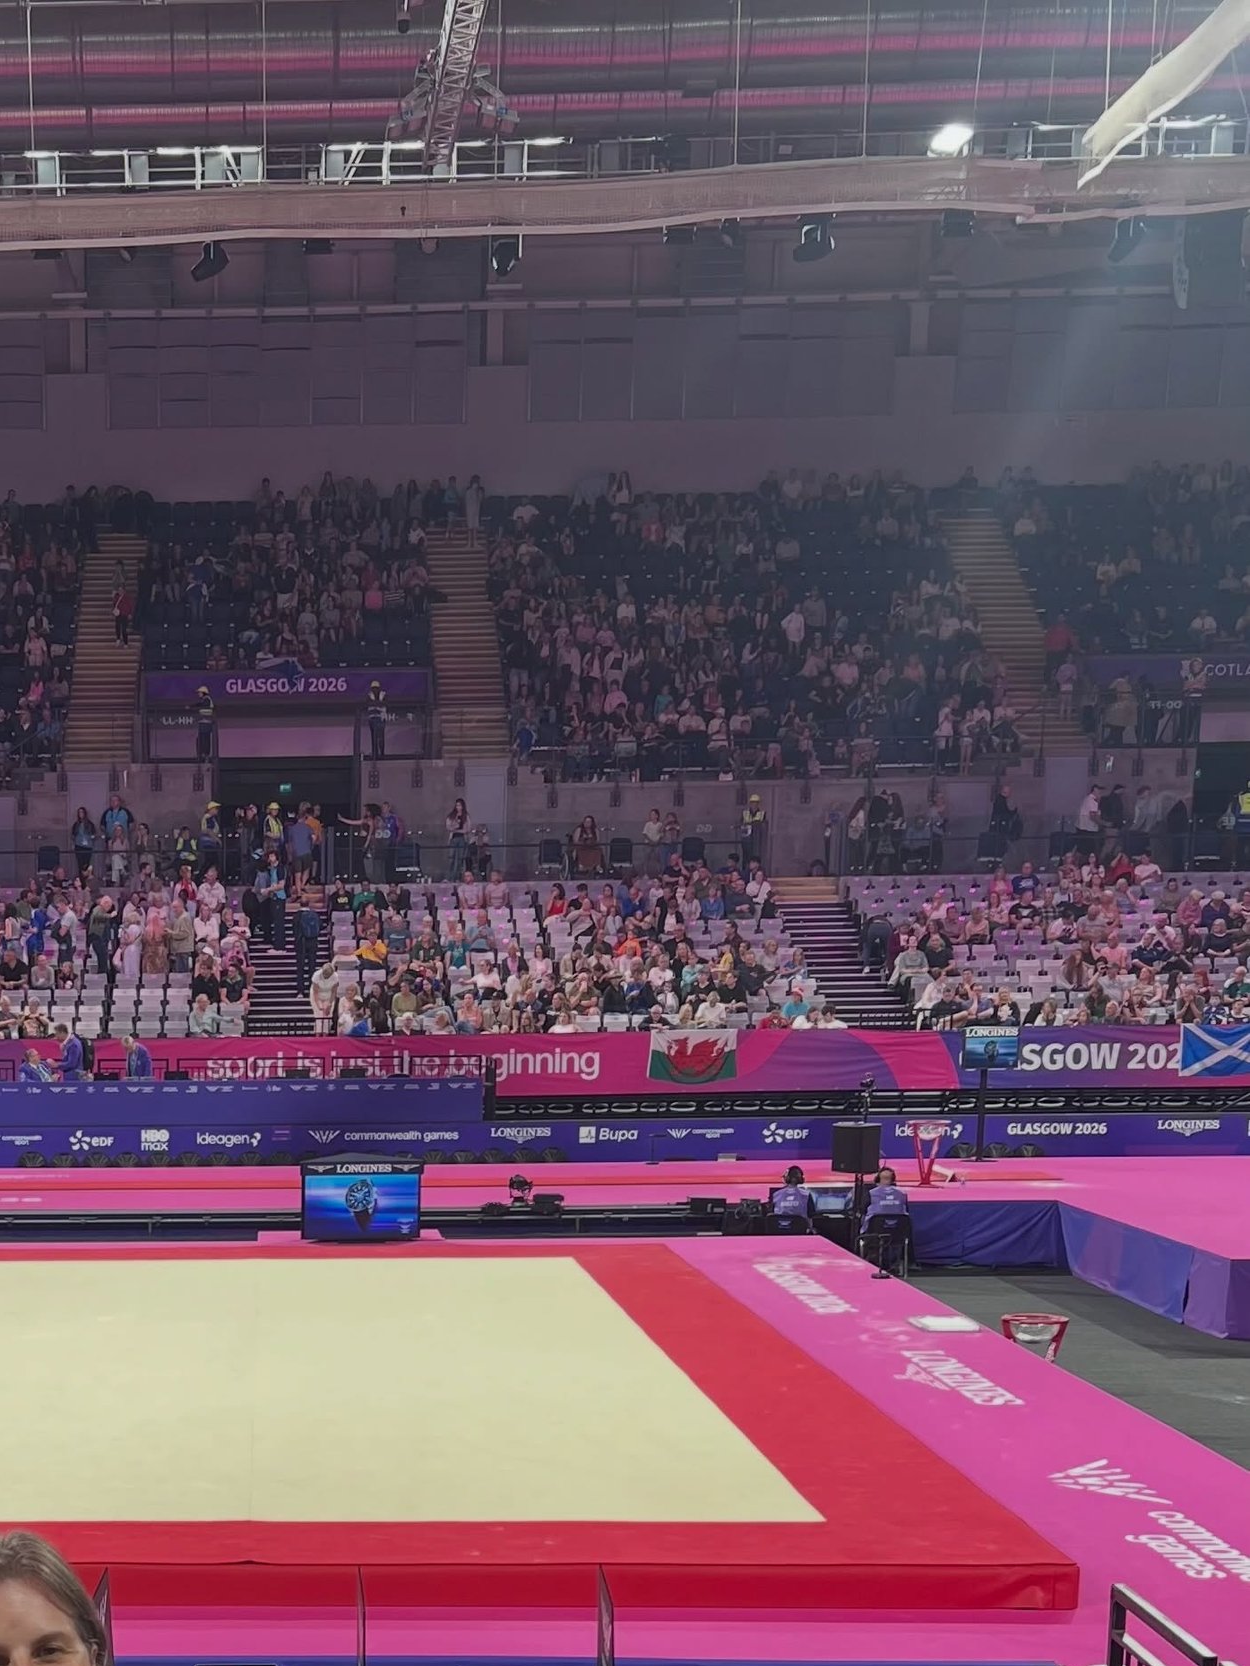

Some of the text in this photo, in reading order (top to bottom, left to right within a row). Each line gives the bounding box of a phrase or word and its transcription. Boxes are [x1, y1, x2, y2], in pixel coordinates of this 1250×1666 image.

[309, 677, 347, 692] 2026
[1007, 1122, 1108, 1135] GLASGOW 2026
[1157, 1119, 1220, 1130] LONGINES
[141, 1129, 170, 1141] HBO
[344, 1130, 459, 1142] commonwealth games
[491, 1127, 551, 1138] LONGINES
[599, 1128, 638, 1142] Bupa
[141, 1141, 169, 1150] max
[197, 1132, 249, 1147] Ideagen
[337, 1164, 392, 1173] LONGINES
[1125, 1534, 1227, 1579] games
